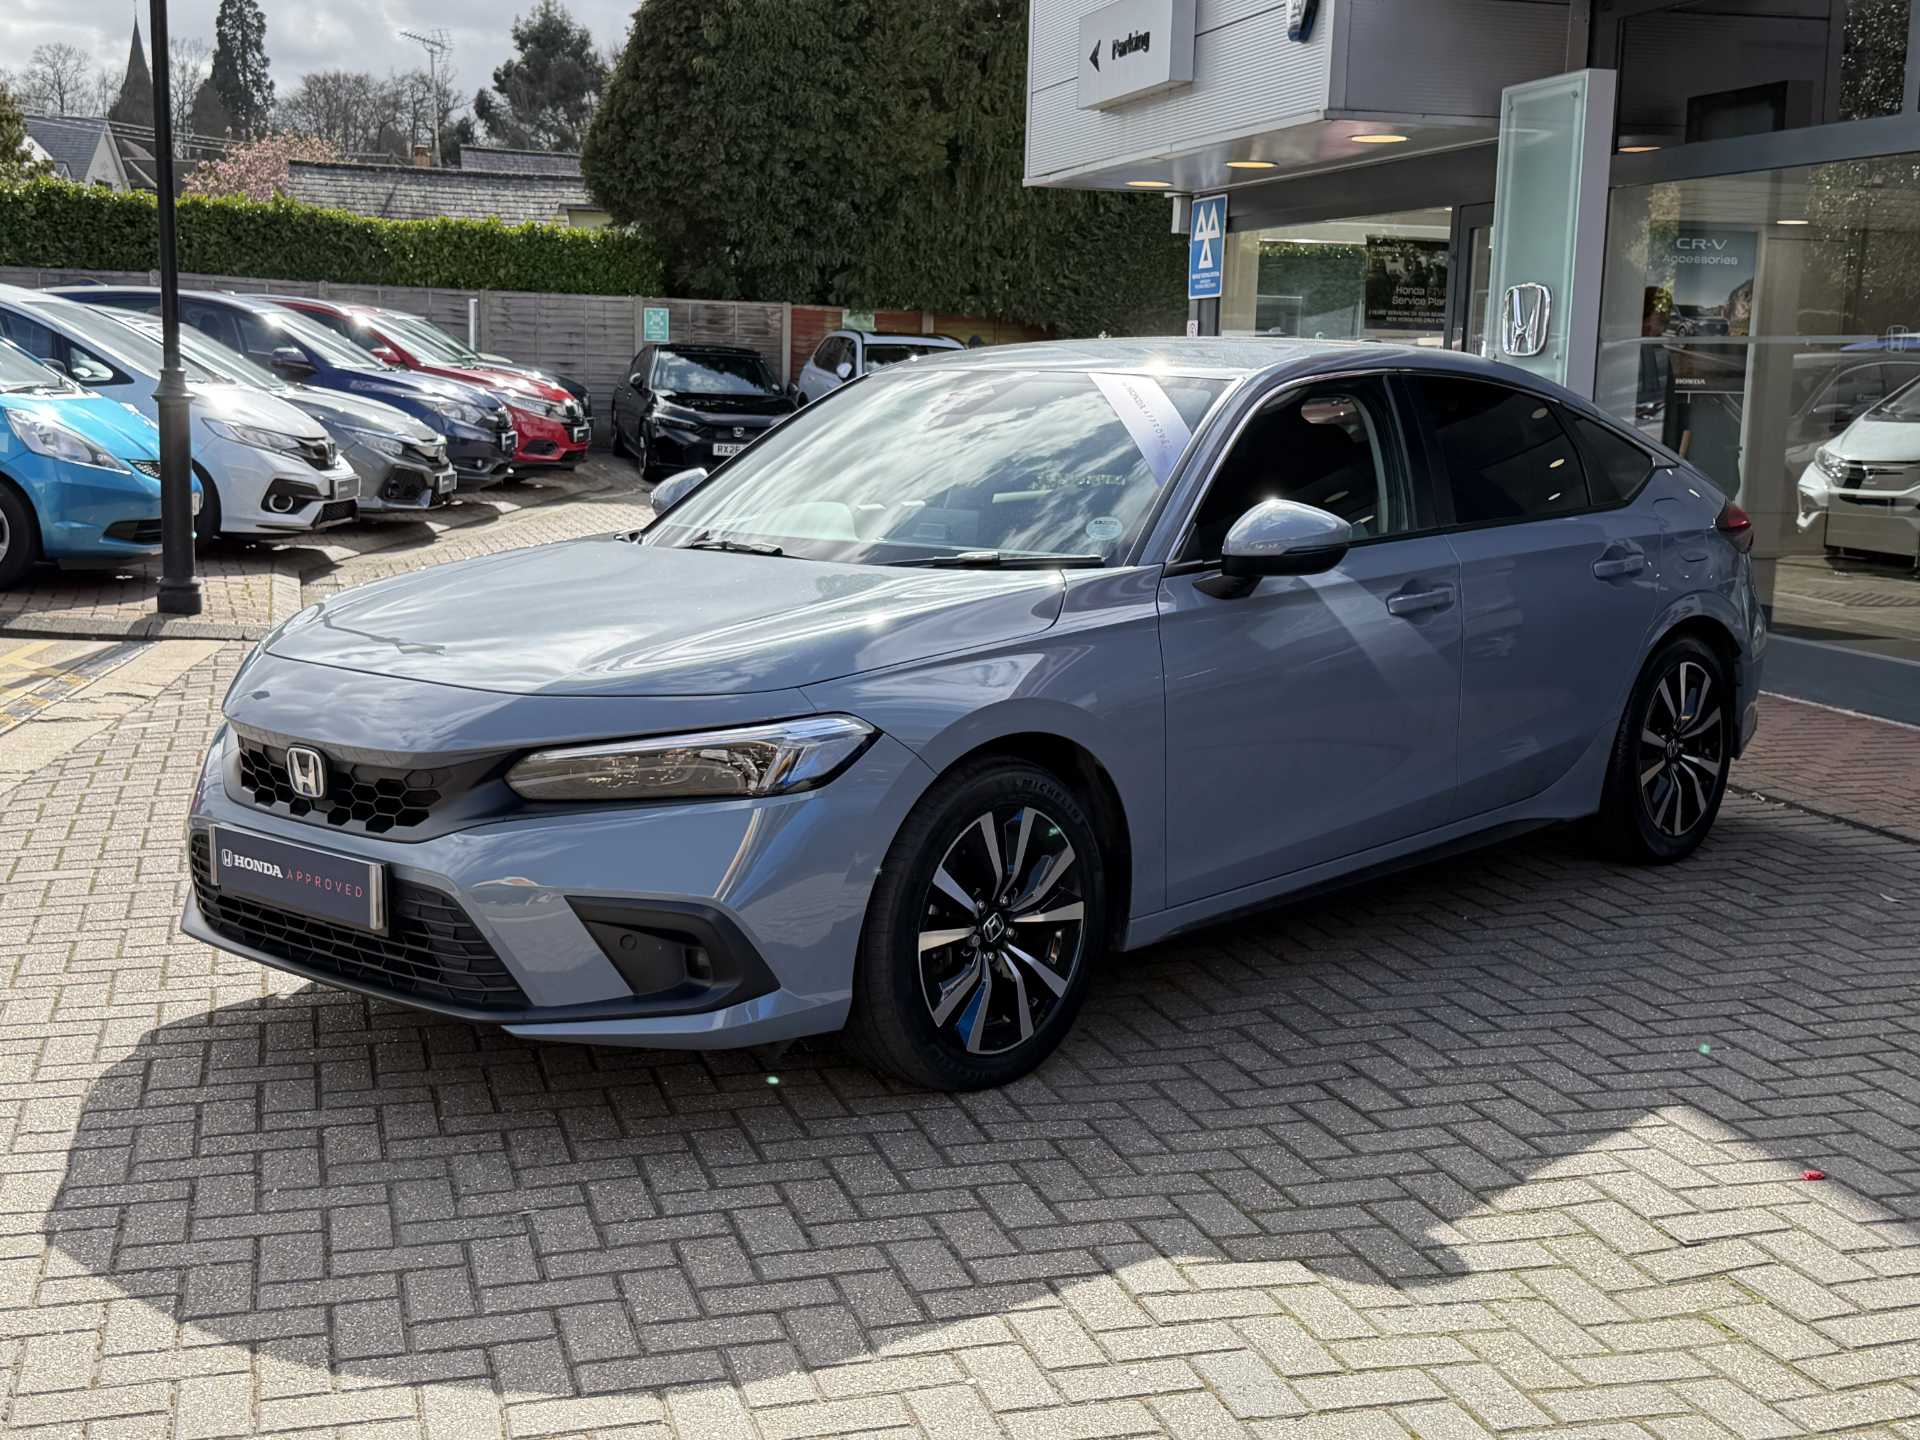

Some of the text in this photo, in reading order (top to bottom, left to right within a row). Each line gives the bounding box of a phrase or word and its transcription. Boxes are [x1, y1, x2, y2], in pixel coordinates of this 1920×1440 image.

[1112, 30, 1150, 60] Parking
[1392, 295, 1426, 306] Service
[1396, 286, 1425, 296] Honda
[232, 853, 284, 879] HONDA
[286, 868, 364, 898] APPROVED
